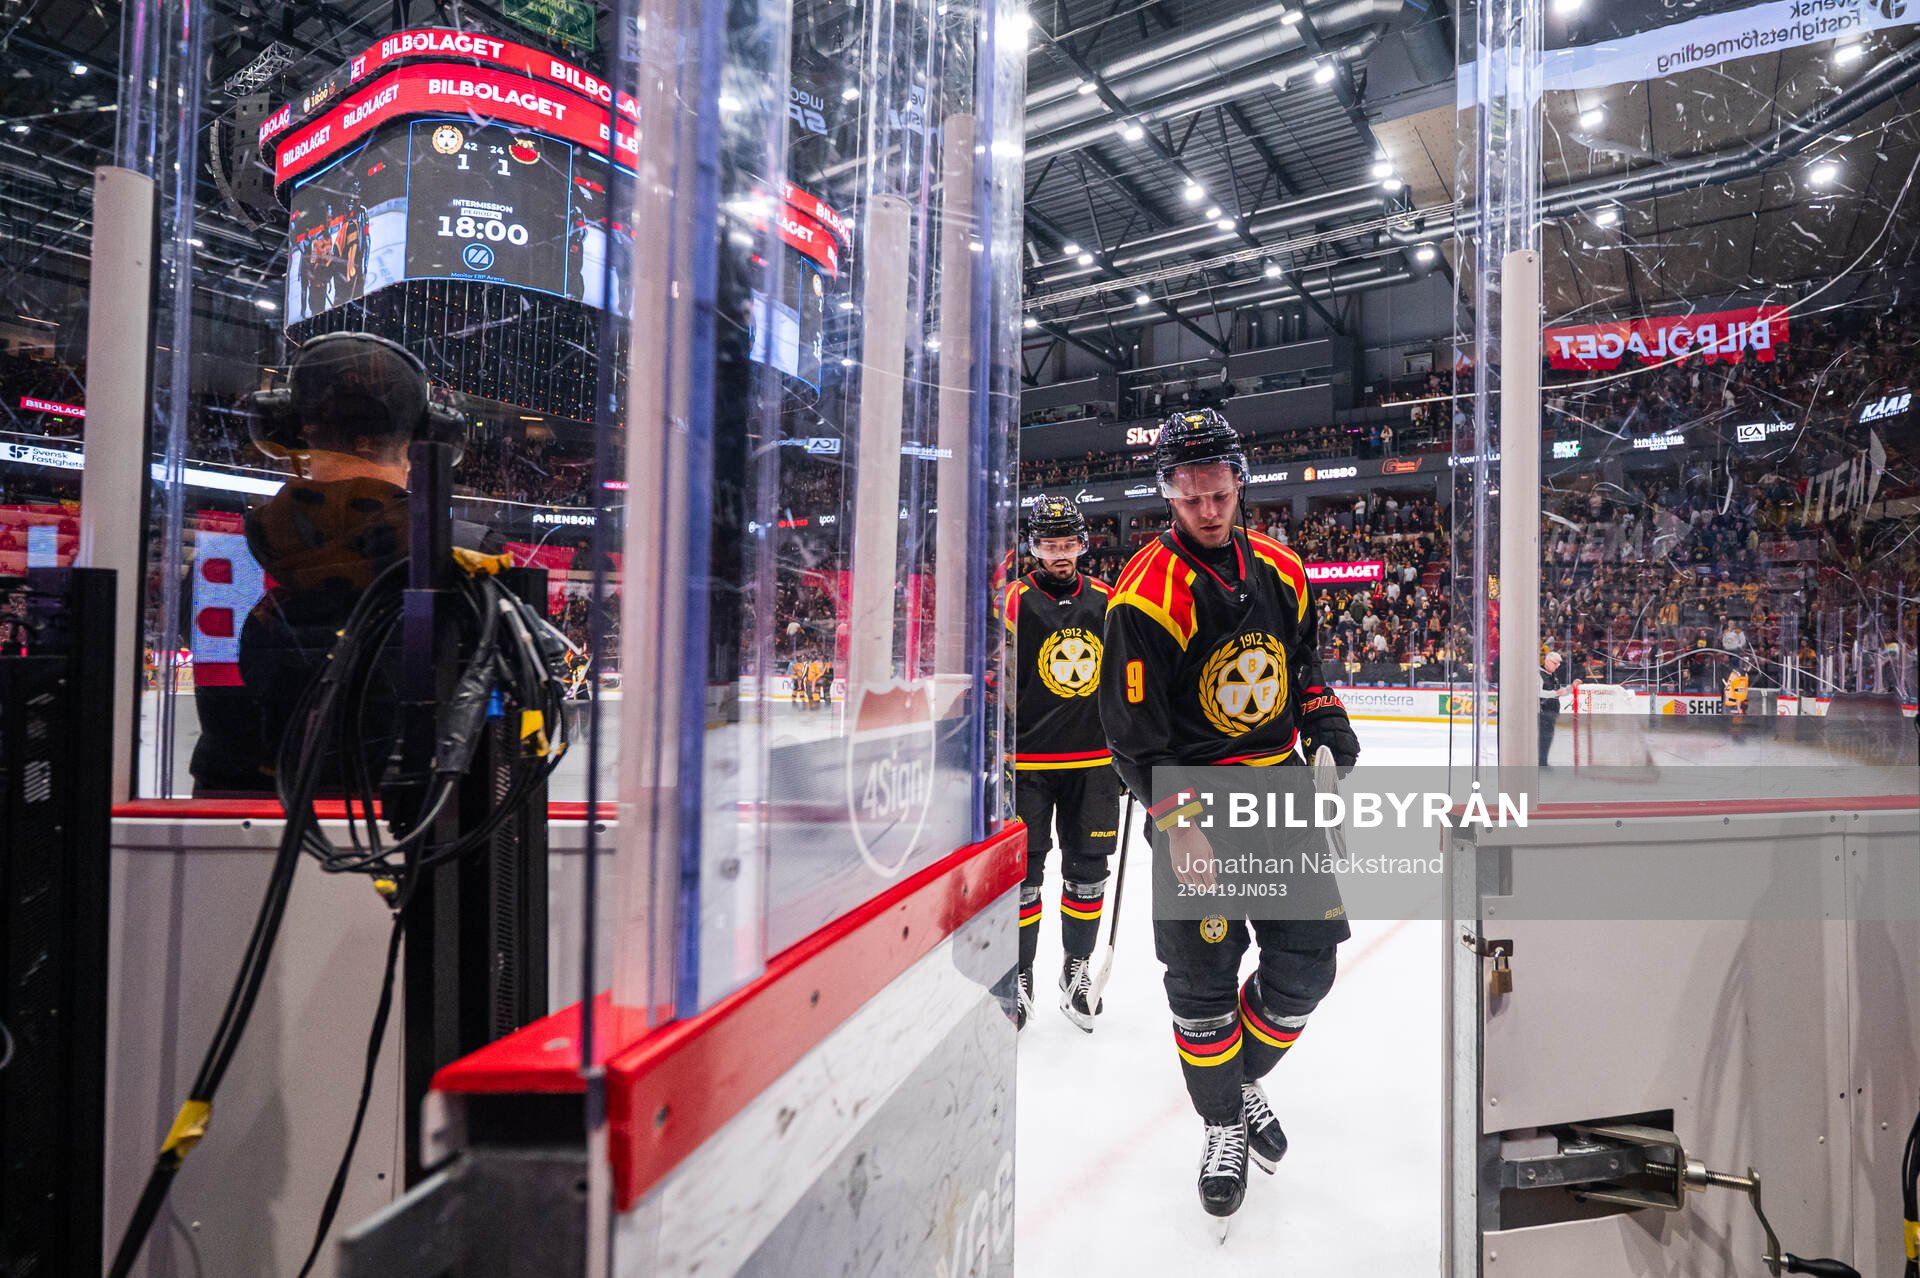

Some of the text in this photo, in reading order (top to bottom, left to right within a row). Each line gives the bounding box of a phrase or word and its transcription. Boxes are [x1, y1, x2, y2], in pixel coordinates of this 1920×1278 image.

[381, 33, 504, 60] BILBOLAGET
[343, 85, 400, 129] BILBOLAGET
[428, 79, 567, 121] BILBOLAGET
[282, 125, 331, 168] BILBOLAGET
[464, 142, 504, 155] 42 24
[457, 154, 511, 176] 1 1
[452, 199, 513, 214] INTERMISSION
[437, 215, 529, 246] 18:00
[25, 399, 86, 416] BILBOLAGE
[1126, 424, 1164, 446] Sky
[1739, 426, 1762, 438] ICA
[31, 455, 85, 468] Fastighets
[545, 514, 595, 526] RENSON
[1061, 627, 1082, 639] 1912
[1239, 632, 1263, 649] 1912
[1069, 644, 1077, 655] B
[1248, 658, 1258, 674] B
[1125, 659, 1145, 705] 9
[1232, 687, 1271, 705] I F
[1342, 692, 1414, 706] orisonterra
[862, 750, 922, 824] 4Sign
[1090, 830, 1117, 838] BAUER
[1183, 1030, 1217, 1038] BAUER
